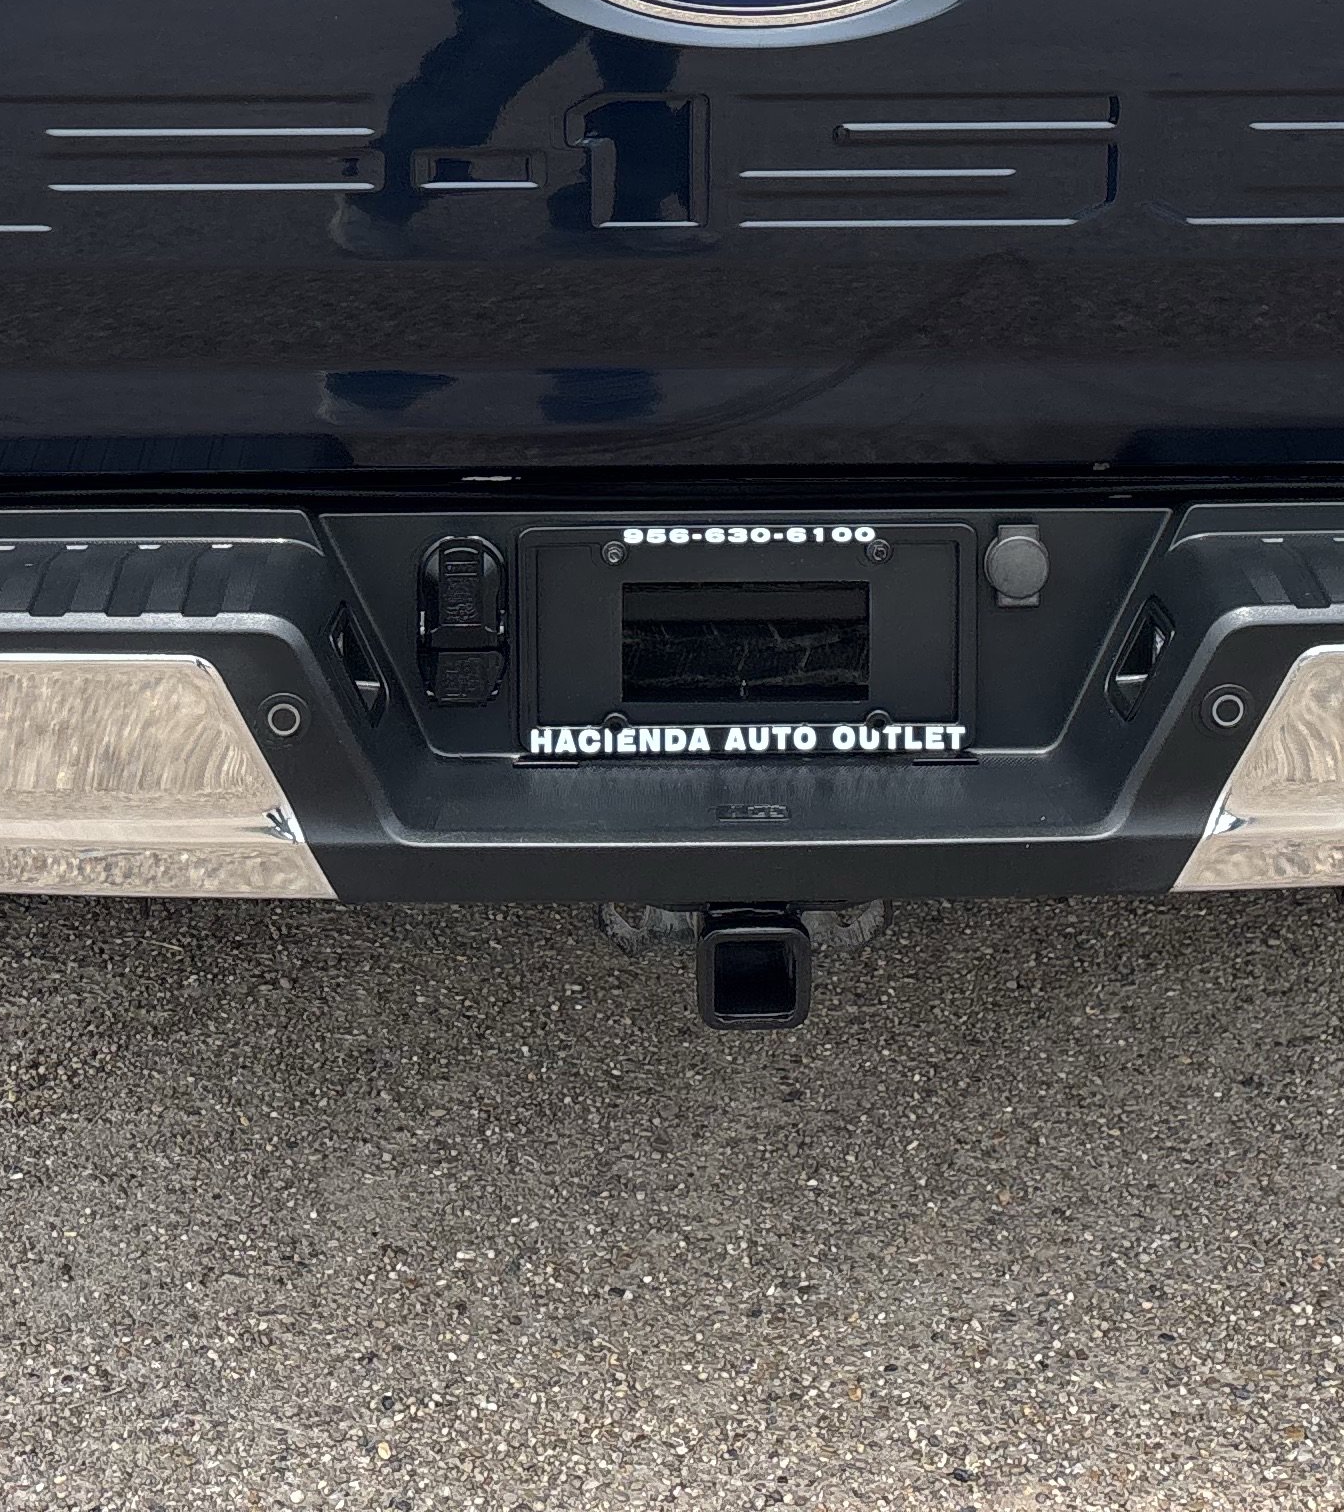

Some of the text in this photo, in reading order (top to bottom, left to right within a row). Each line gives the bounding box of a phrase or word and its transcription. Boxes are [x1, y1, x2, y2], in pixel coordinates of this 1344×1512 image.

[622, 526, 876, 544] 956-630-6100
[529, 725, 966, 754] HACIENDA AUTO OUTLET
